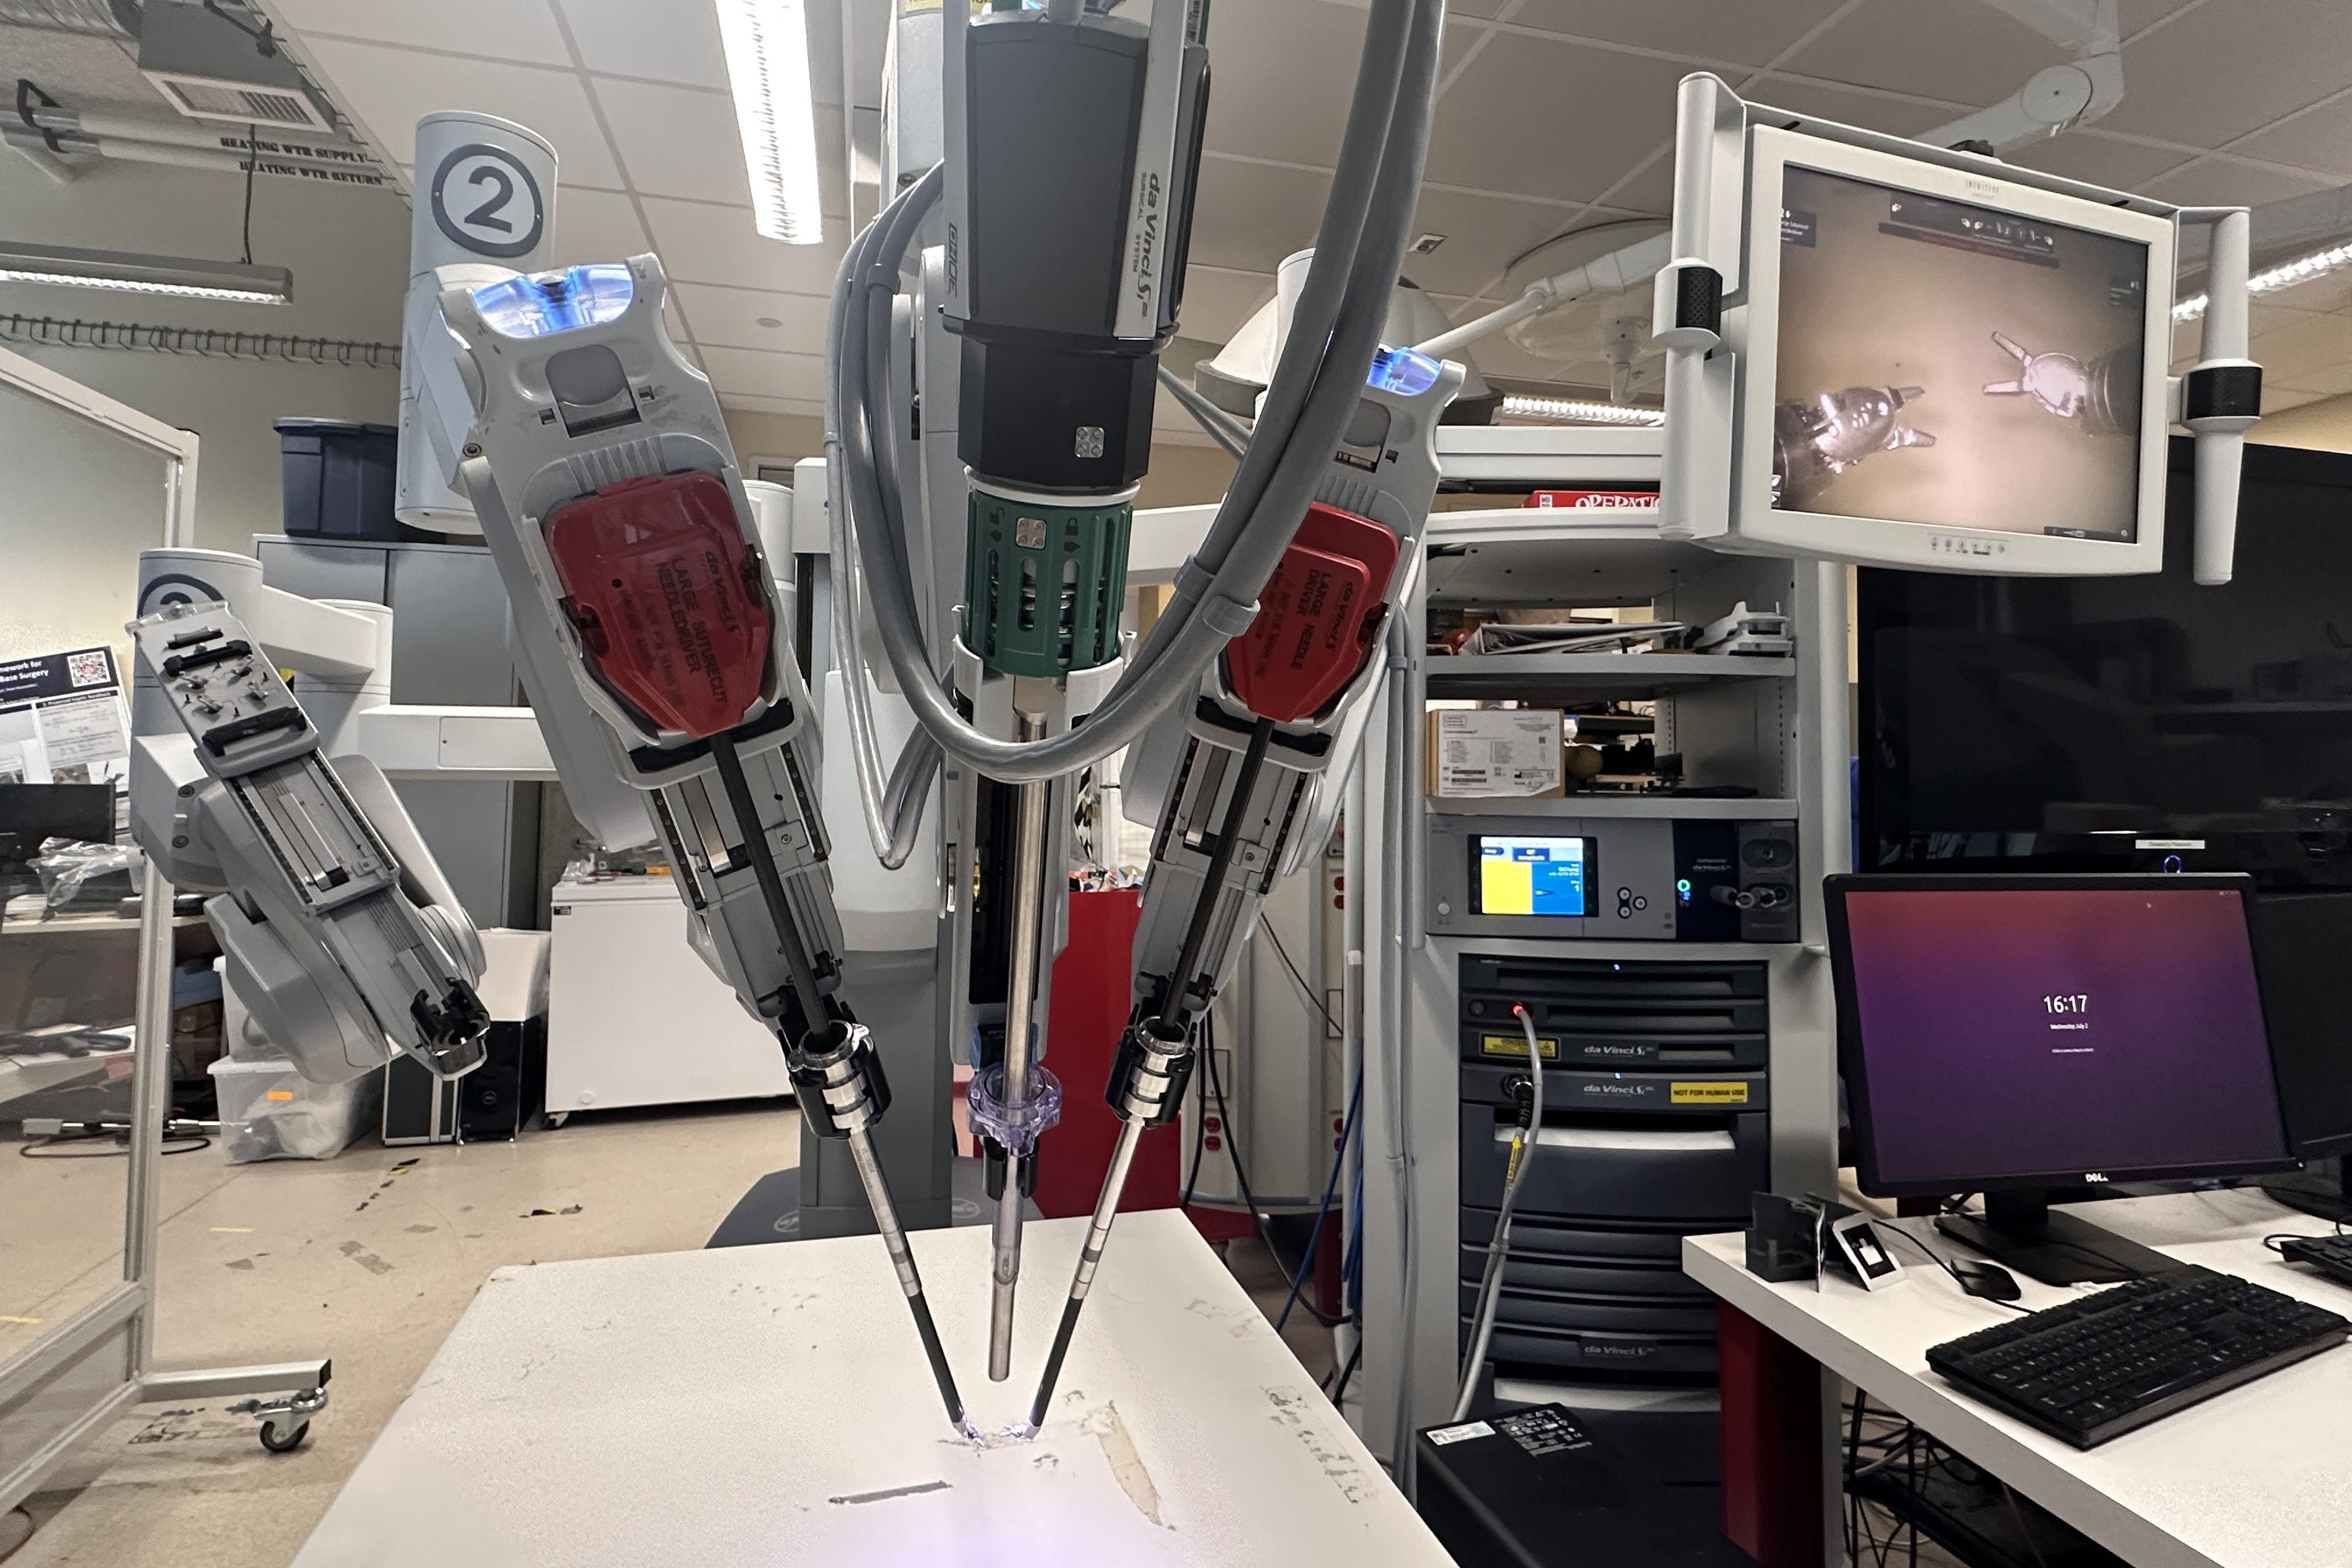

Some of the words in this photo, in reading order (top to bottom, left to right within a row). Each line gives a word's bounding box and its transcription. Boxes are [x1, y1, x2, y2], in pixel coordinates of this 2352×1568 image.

[282, 144, 313, 156] WTR
[315, 149, 366, 163] SUPPLY
[239, 160, 296, 176] HATING
[299, 167, 330, 180] WTR
[331, 172, 382, 185] RETURN
[464, 166, 513, 233] 2
[1138, 172, 1147, 221] SURGICAL
[1147, 173, 1160, 209] da
[1132, 234, 1141, 272] SYSTEM
[705, 551, 719, 575] da
[1296, 569, 1320, 616] DRIVER
[1310, 570, 1332, 617] LARGE
[1342, 582, 1354, 602] da
[656, 562, 701, 674] NEEDLEDRIVER
[671, 557, 700, 611] LARGE
[691, 620, 728, 703] SUTURECUT
[1290, 623, 1315, 670] NEEDLE
[19, 670, 48, 680] Surgery
[2043, 995, 2087, 1013] 16:17
[1584, 1045, 1601, 1054] da
[1584, 1084, 1601, 1093] da
[1584, 1345, 1602, 1353] da
